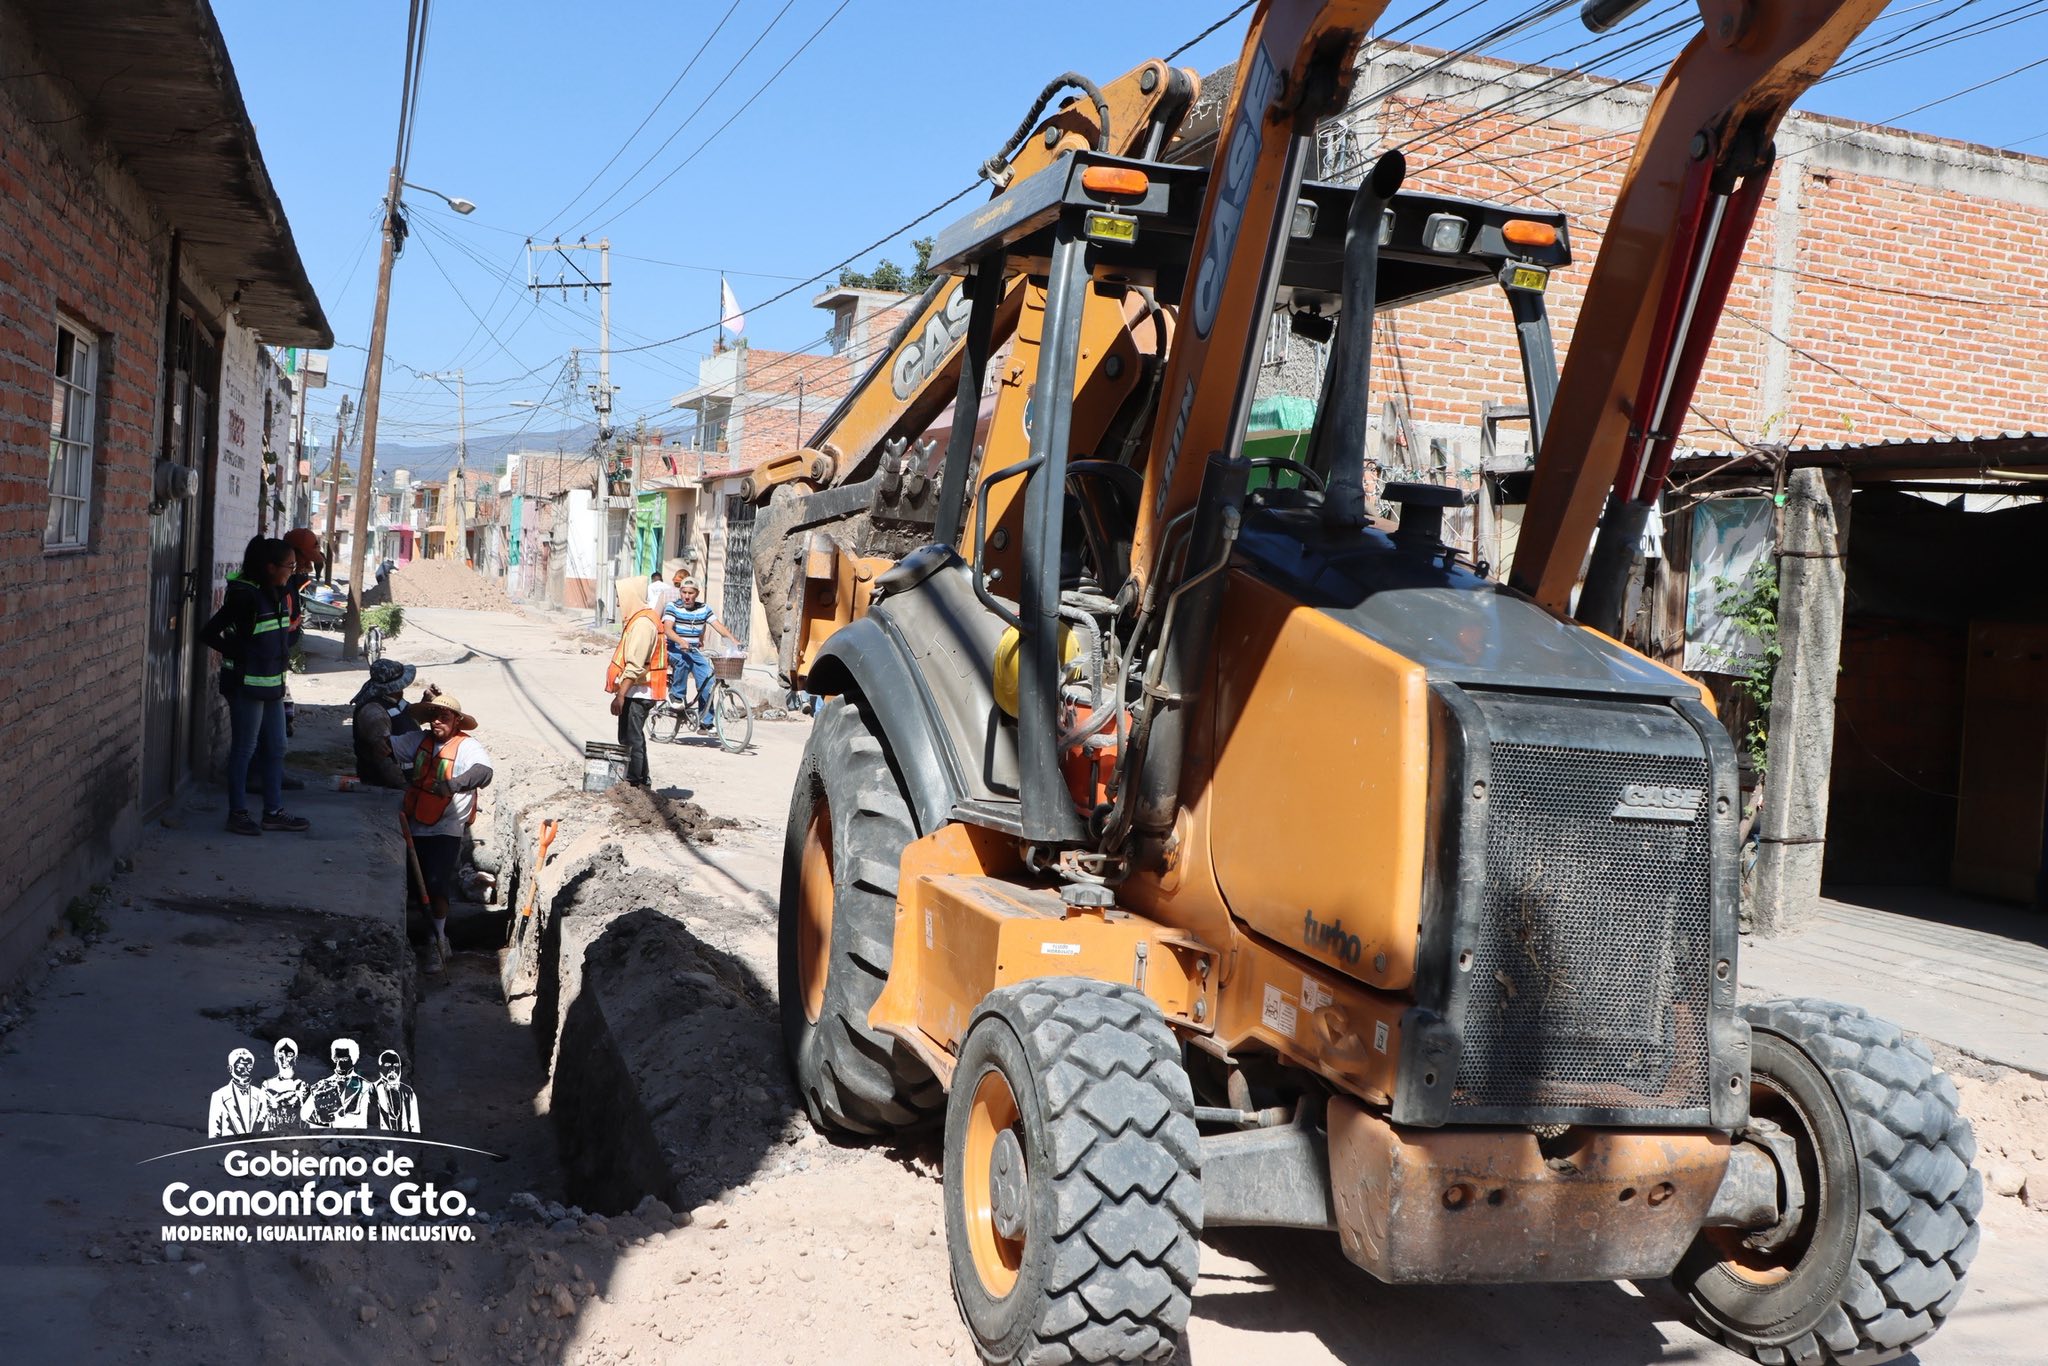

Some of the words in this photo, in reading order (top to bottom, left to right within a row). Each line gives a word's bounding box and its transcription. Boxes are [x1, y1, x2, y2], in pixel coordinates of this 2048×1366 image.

[1192, 38, 1276, 340] CASE
[892, 278, 974, 401] CAS
[1620, 784, 1703, 809] CASE
[1303, 908, 1362, 966] turbo
